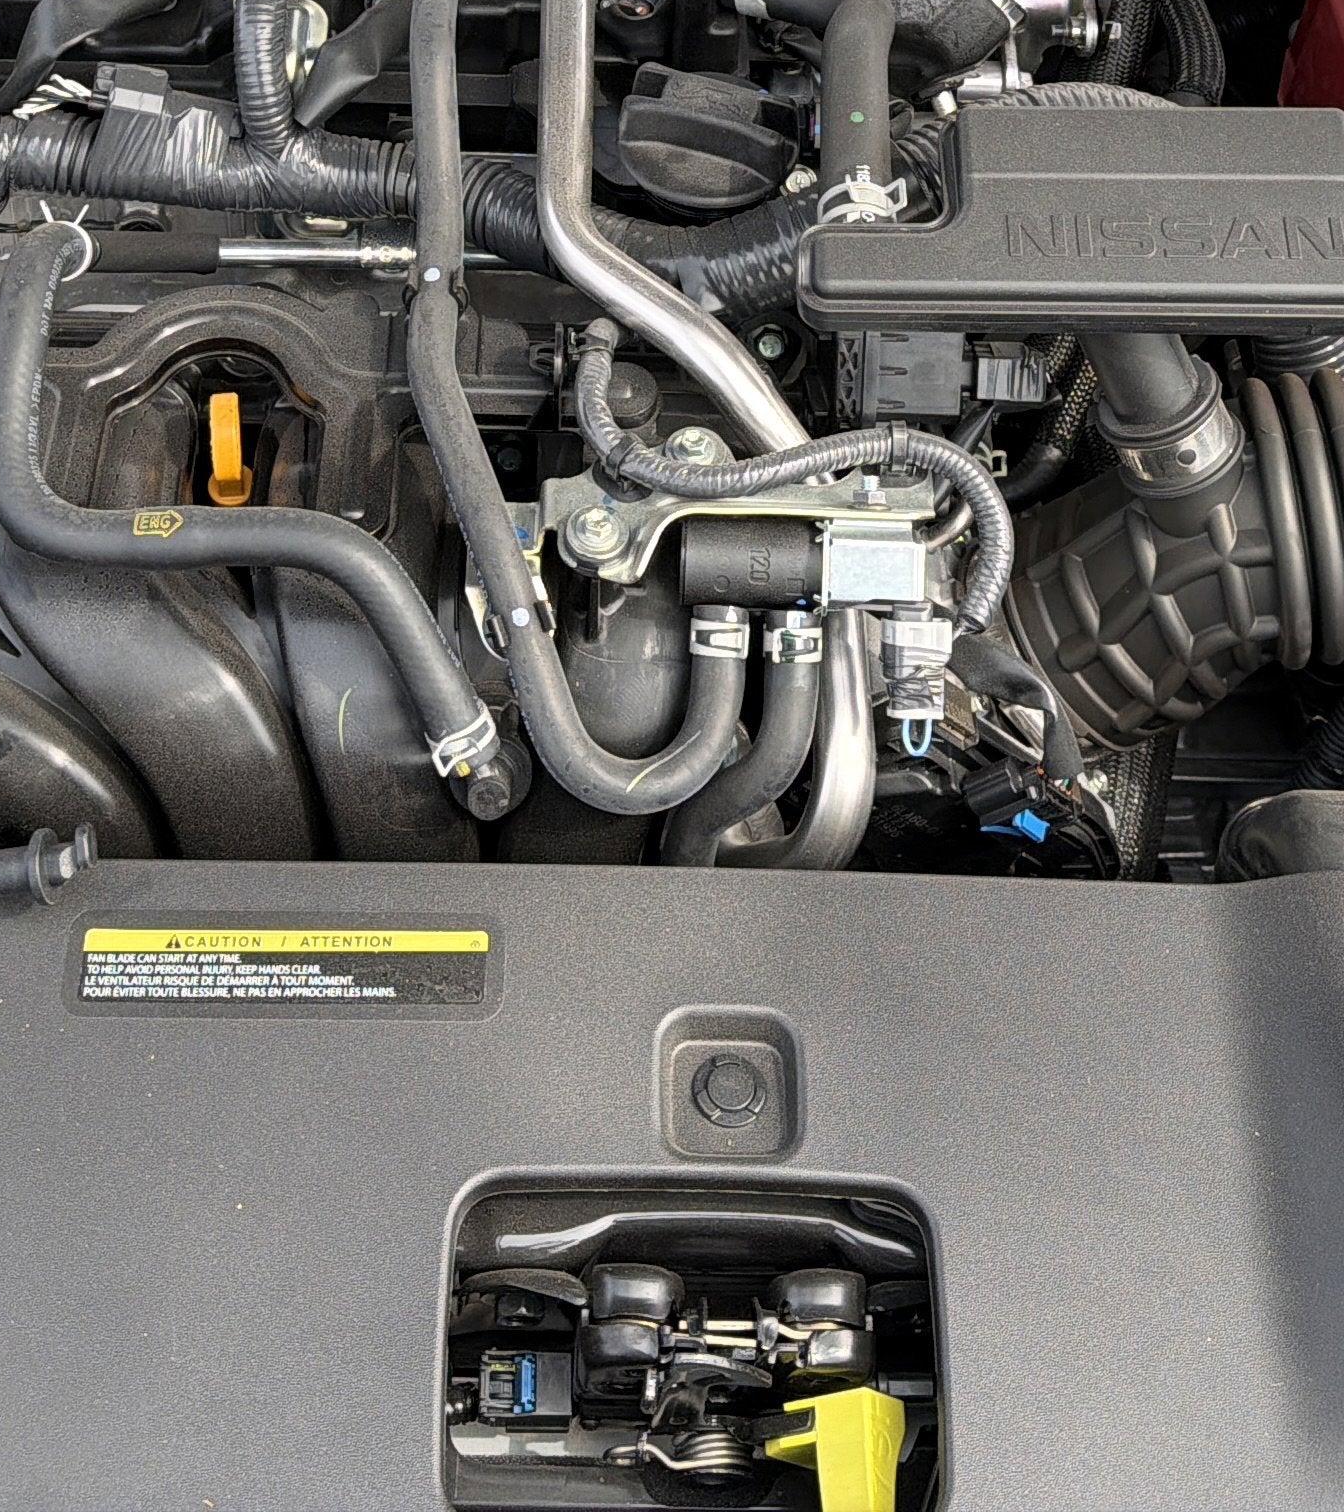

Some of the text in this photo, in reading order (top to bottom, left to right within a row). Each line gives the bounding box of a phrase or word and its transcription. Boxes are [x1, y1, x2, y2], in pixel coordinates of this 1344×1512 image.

[139, 514, 171, 530] ENG
[185, 936, 393, 947] CAUTION / ATTENTION
[87, 953, 242, 963] FAN BLADE CAN START AT ANY TIME.
[87, 965, 321, 975] TO HELP AVOID PERSONAL INJURY, KEEP HANDS CLEAR.
[85, 974, 355, 986] LE VENTILATEUR RISQUE DE DÉMARRER À TOUT MOMENT.
[83, 986, 397, 997] POUR ÉVITER TOUTE BLESSURE, NE PAS EN APPROCHER LES MAINS.
